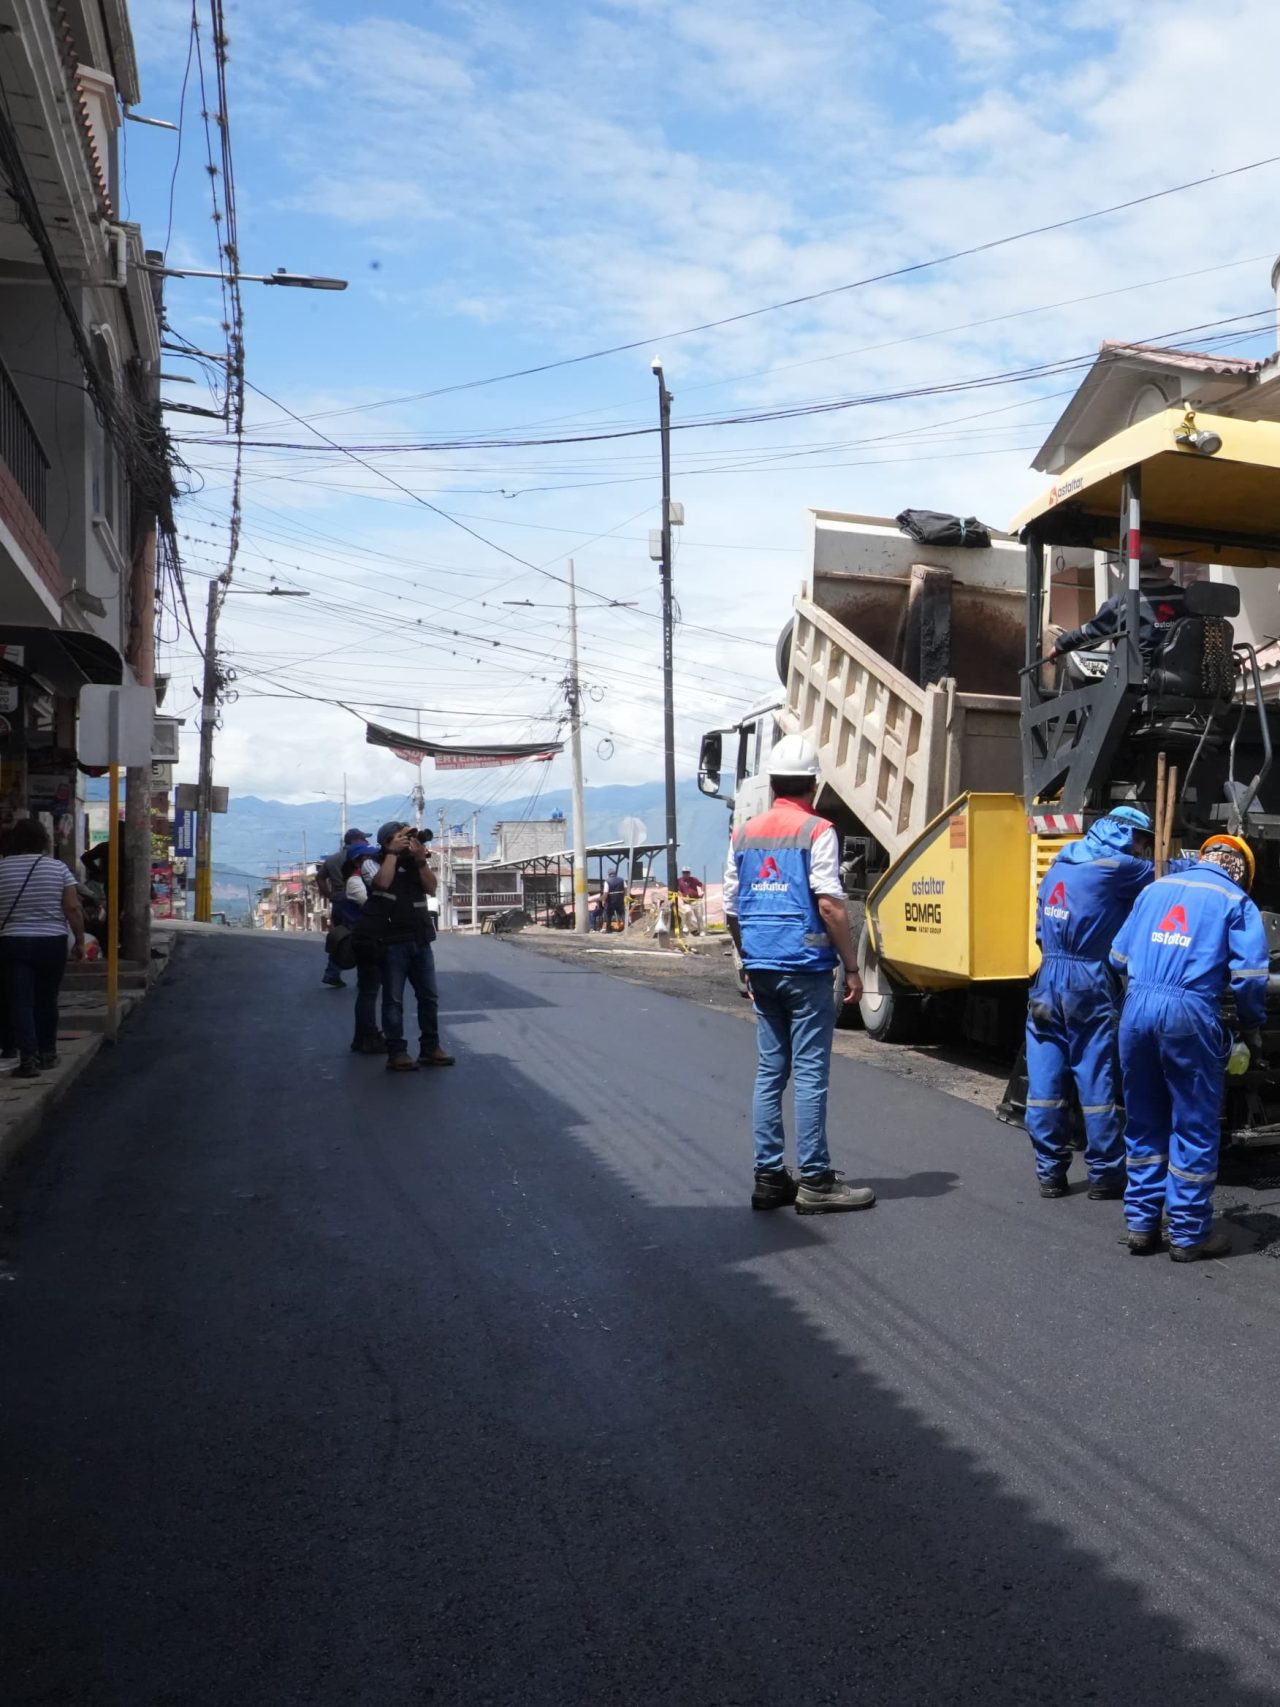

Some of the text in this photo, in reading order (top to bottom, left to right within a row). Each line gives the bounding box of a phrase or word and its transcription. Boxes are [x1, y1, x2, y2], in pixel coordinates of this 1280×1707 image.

[912, 876, 945, 895] asfaltar
[905, 902, 942, 924] BOMAG
[1151, 931, 1192, 947] asfaltar
